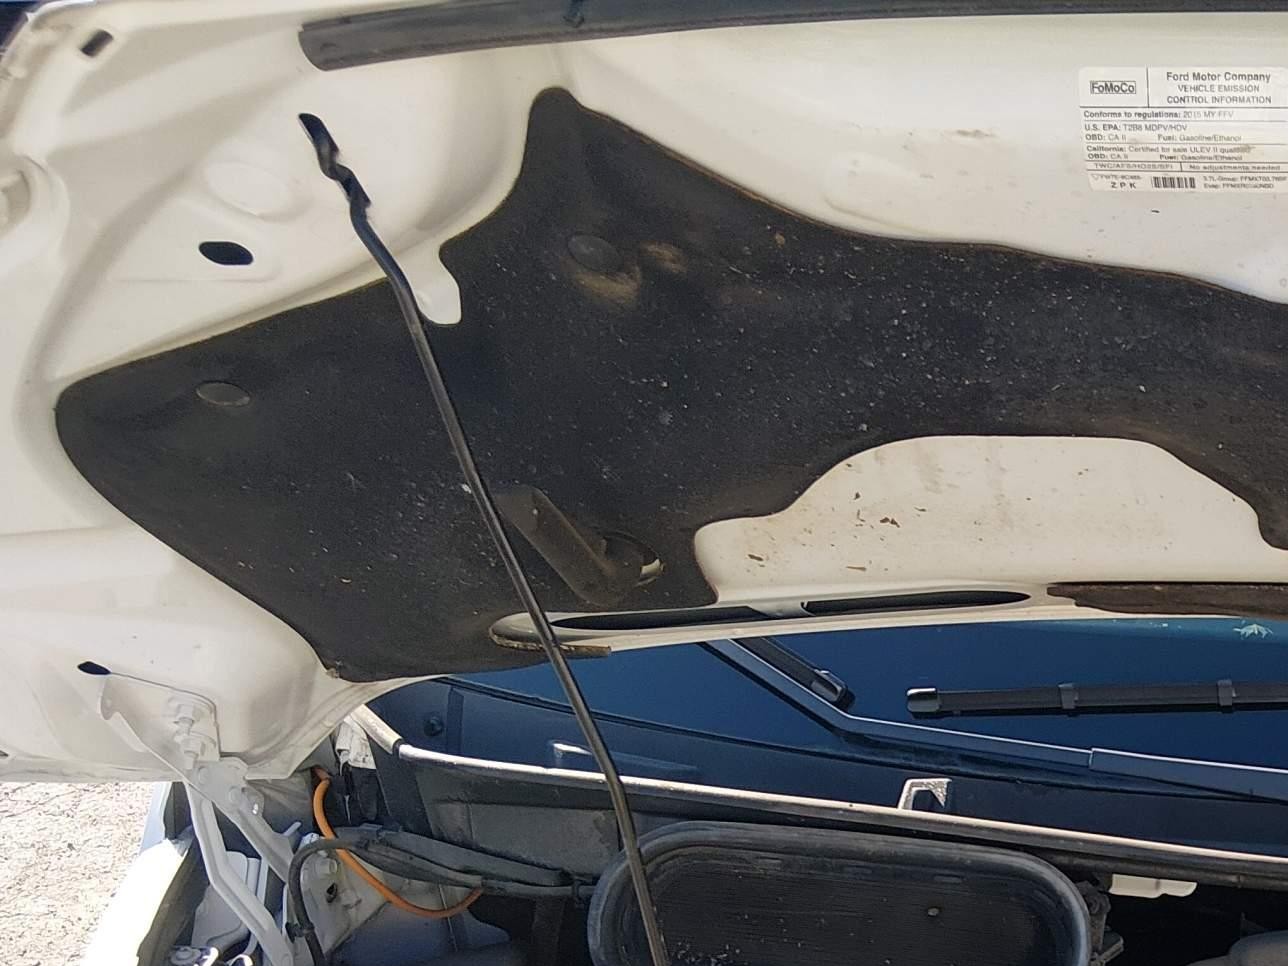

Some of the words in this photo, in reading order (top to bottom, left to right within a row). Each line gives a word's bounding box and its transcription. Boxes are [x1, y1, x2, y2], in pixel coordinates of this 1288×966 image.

[1167, 71, 1189, 82] Ford
[1192, 71, 1221, 82] Motor
[1224, 71, 1271, 84] Company
[1091, 81, 1136, 94] FoMoCo
[1178, 84, 1215, 93] VEHICLE
[1217, 84, 1260, 93] EMISSION
[1167, 95, 1210, 104] CONTROL
[1211, 95, 1272, 105] INFORMATION
[1083, 110, 1122, 118] Conforms
[1124, 110, 1133, 118] to
[1134, 110, 1181, 120] regulations:
[1204, 110, 1216, 118] MY
[1084, 123, 1100, 131] U.S.
[1102, 123, 1121, 131] EPA:
[1085, 133, 1106, 141] OBD:
[1108, 133, 1120, 141] CA
[1157, 133, 1178, 142] Fuel:
[1179, 133, 1242, 142] Gasoline/Ethanol
[1086, 144, 1127, 153] California:
[1128, 144, 1160, 153] Certified
[1189, 144, 1211, 153] ULEV
